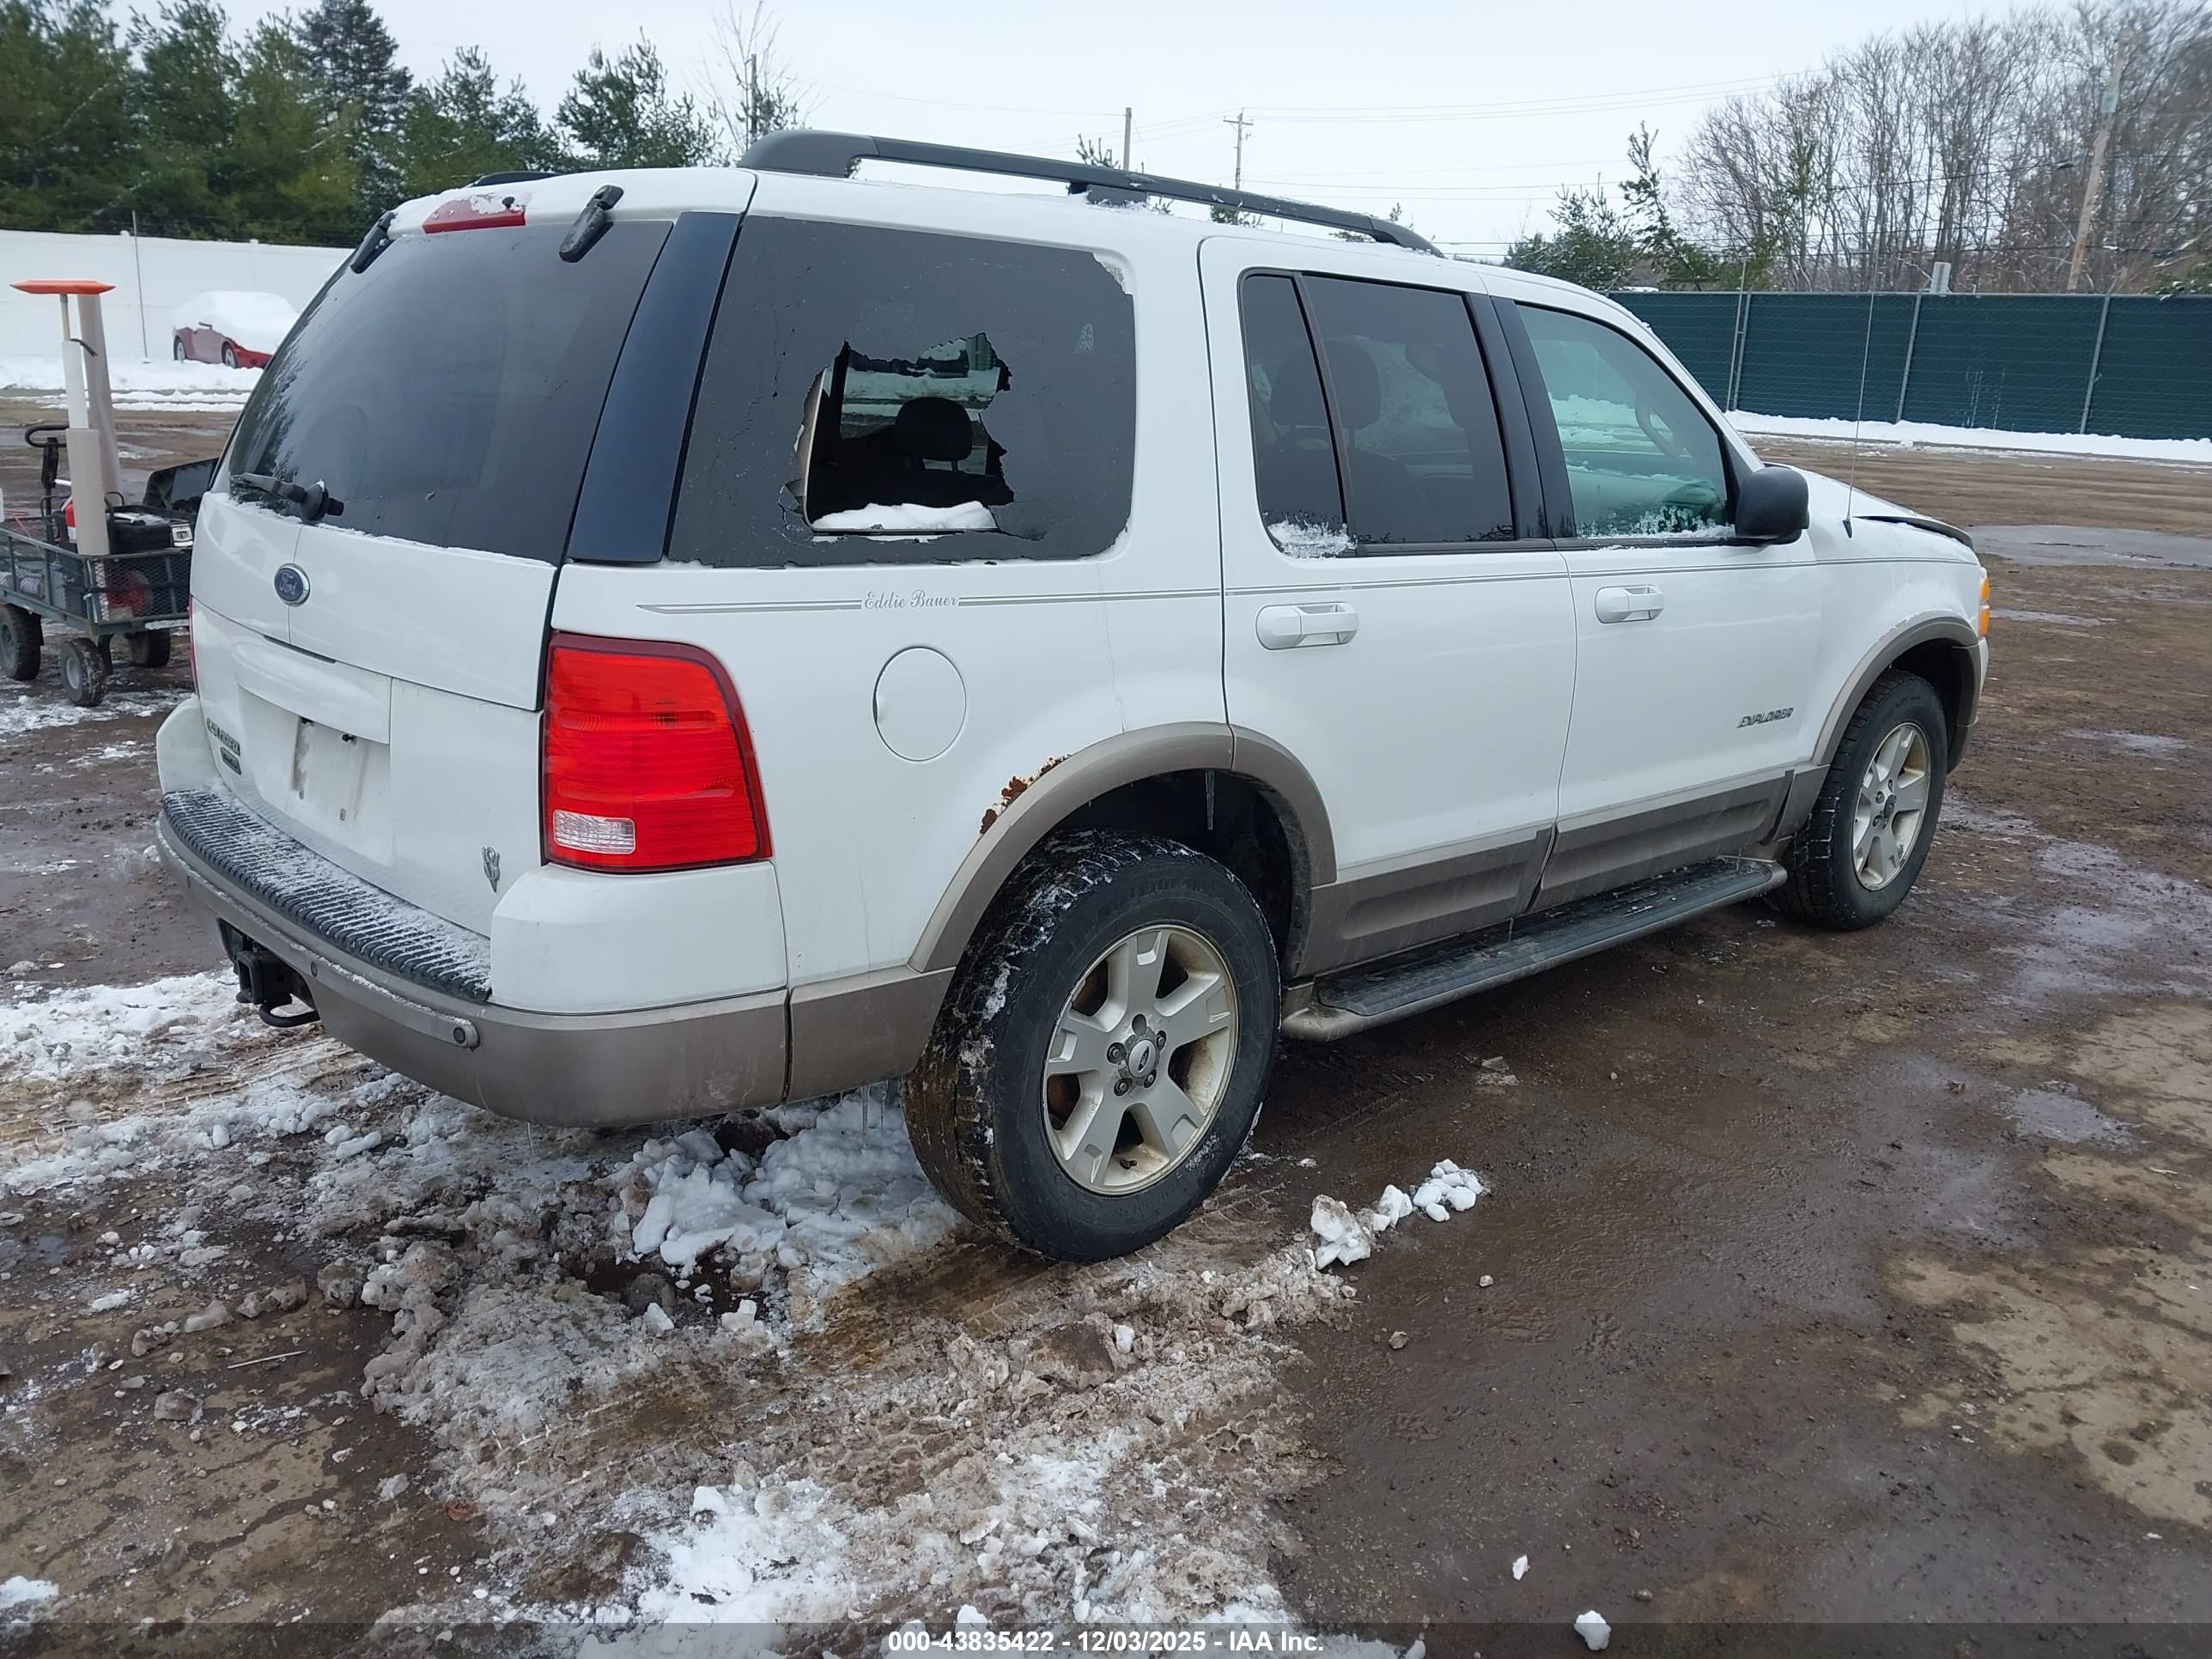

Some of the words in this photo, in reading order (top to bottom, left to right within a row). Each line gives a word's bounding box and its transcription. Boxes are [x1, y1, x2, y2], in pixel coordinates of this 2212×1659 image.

[279, 572, 297, 594] Ford
[865, 591, 907, 610] Eddie
[911, 589, 958, 608] Bauer
[1735, 707, 1794, 729] EXPLORER
